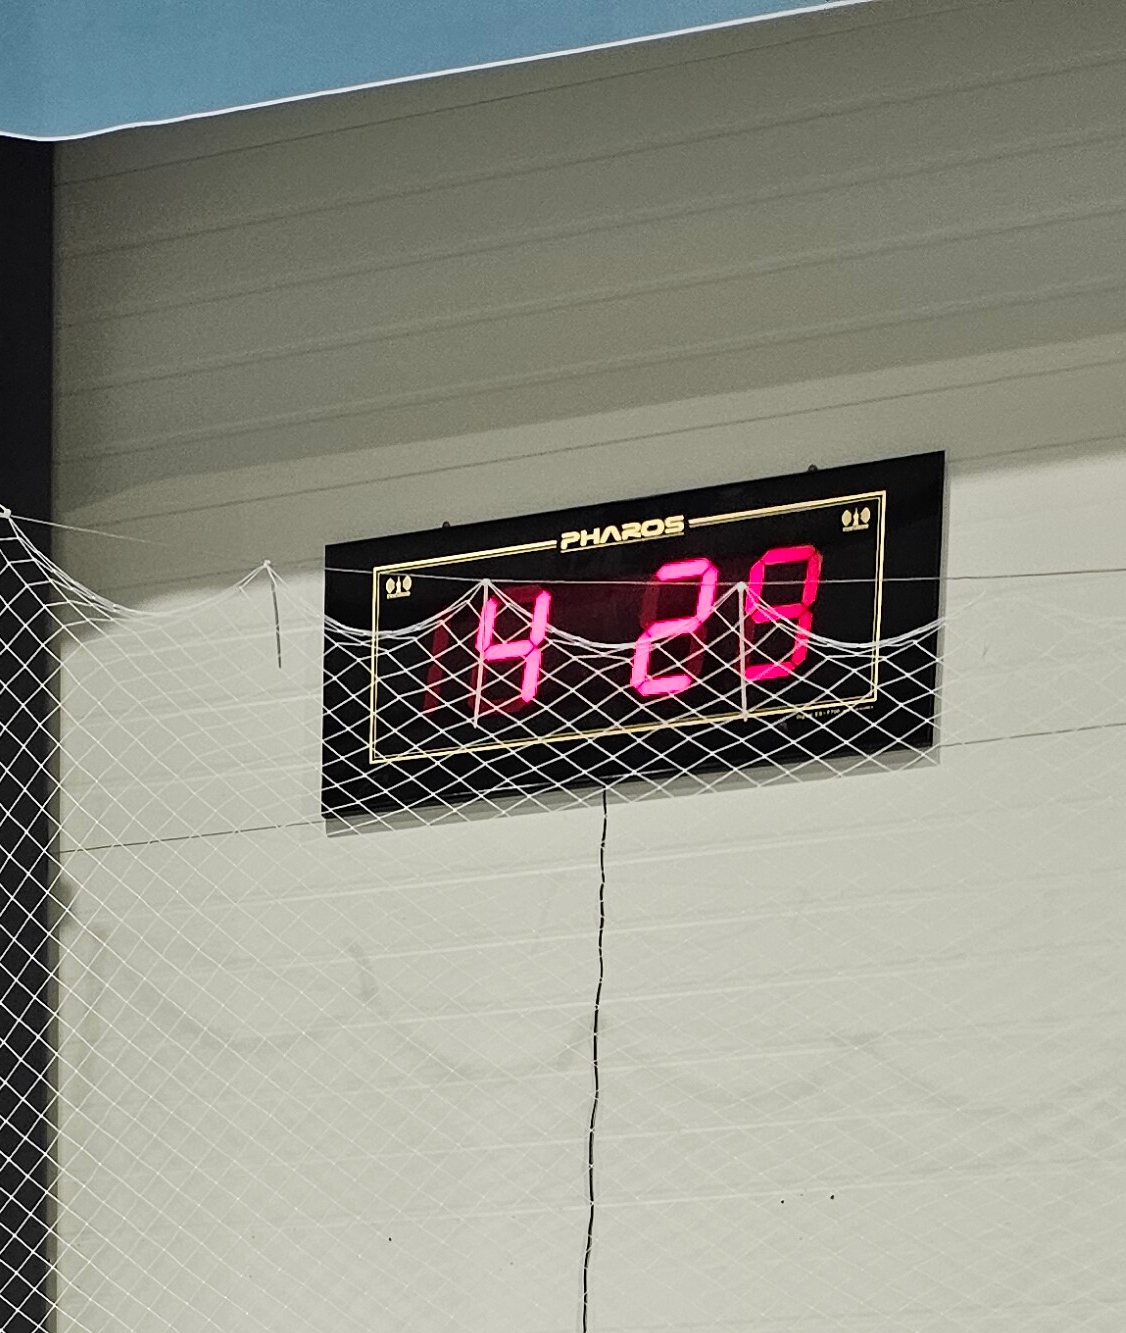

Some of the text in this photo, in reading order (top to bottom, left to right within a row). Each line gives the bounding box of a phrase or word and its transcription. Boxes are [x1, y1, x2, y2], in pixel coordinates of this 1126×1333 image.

[560, 514, 685, 553] PHAROS
[476, 545, 823, 703] 4 29
